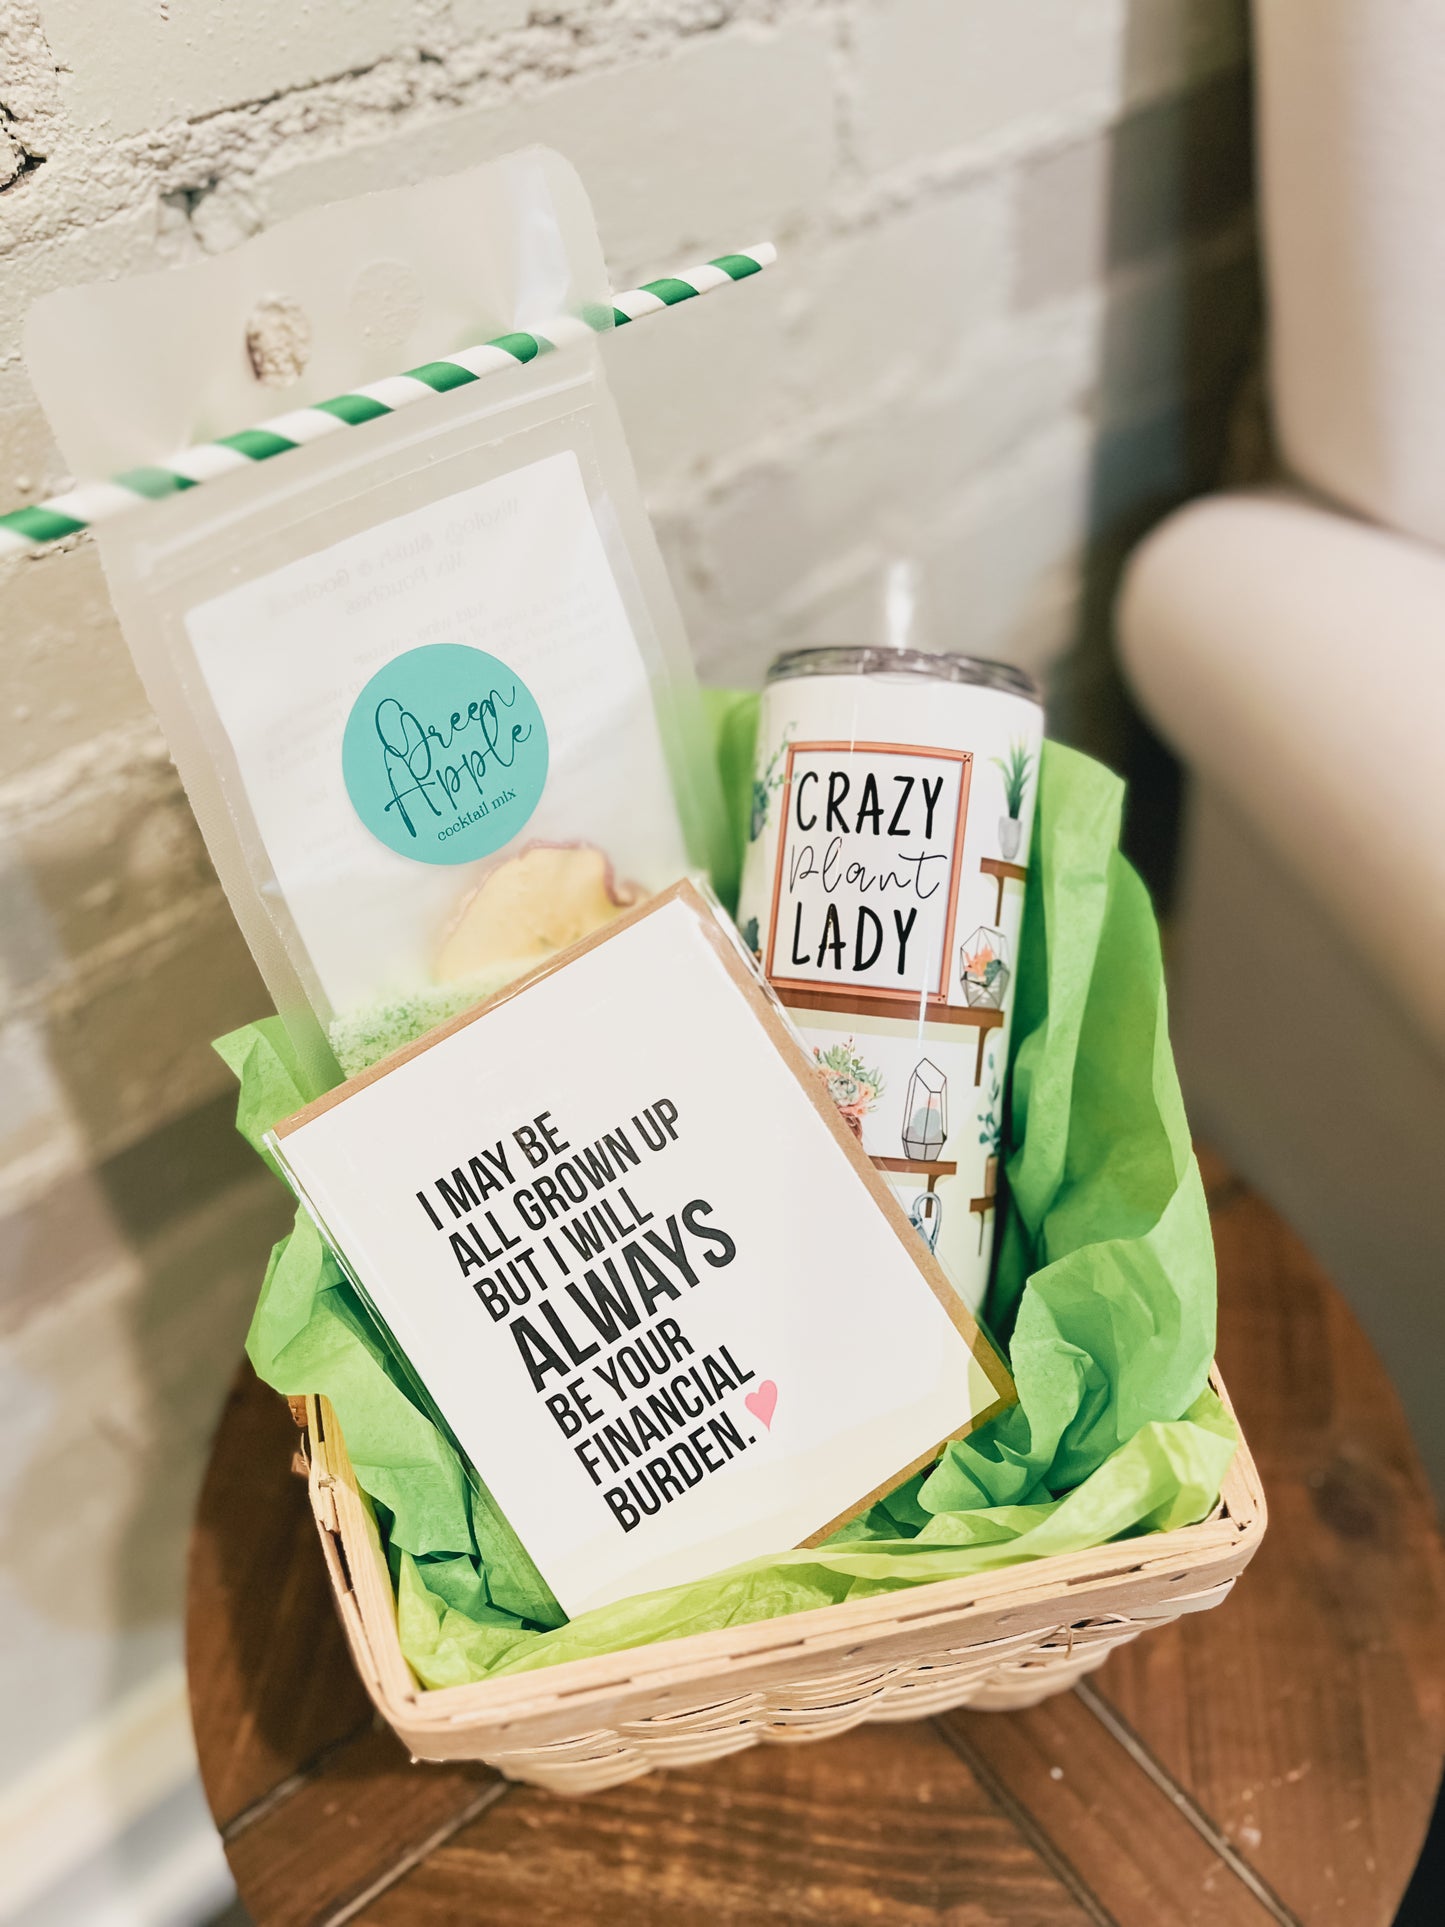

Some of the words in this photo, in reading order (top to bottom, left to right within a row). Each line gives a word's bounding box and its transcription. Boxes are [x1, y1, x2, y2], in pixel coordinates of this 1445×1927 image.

[374, 685, 516, 781] Green
[384, 699, 533, 839] Apple
[437, 801, 491, 842] cocktail
[492, 788, 518, 811] mix
[796, 771, 944, 840] CRAZY
[791, 901, 918, 976] LADY
[416, 1190, 445, 1231] I
[435, 1141, 517, 1220] MAY
[512, 1110, 571, 1170] BE
[449, 1211, 522, 1278] ALL
[512, 1126, 641, 1231] GROWN
[630, 1098, 679, 1152] UP
[472, 1247, 549, 1323] BUT
[543, 1236, 570, 1277] I
[560, 1187, 654, 1263] WILL
[508, 1199, 737, 1394] ALWAYS
[545, 1377, 605, 1440] BE
[592, 1317, 696, 1402] YOUR
[573, 1344, 756, 1487] FINANCIAL
[602, 1410, 757, 1534] BURDEN.
